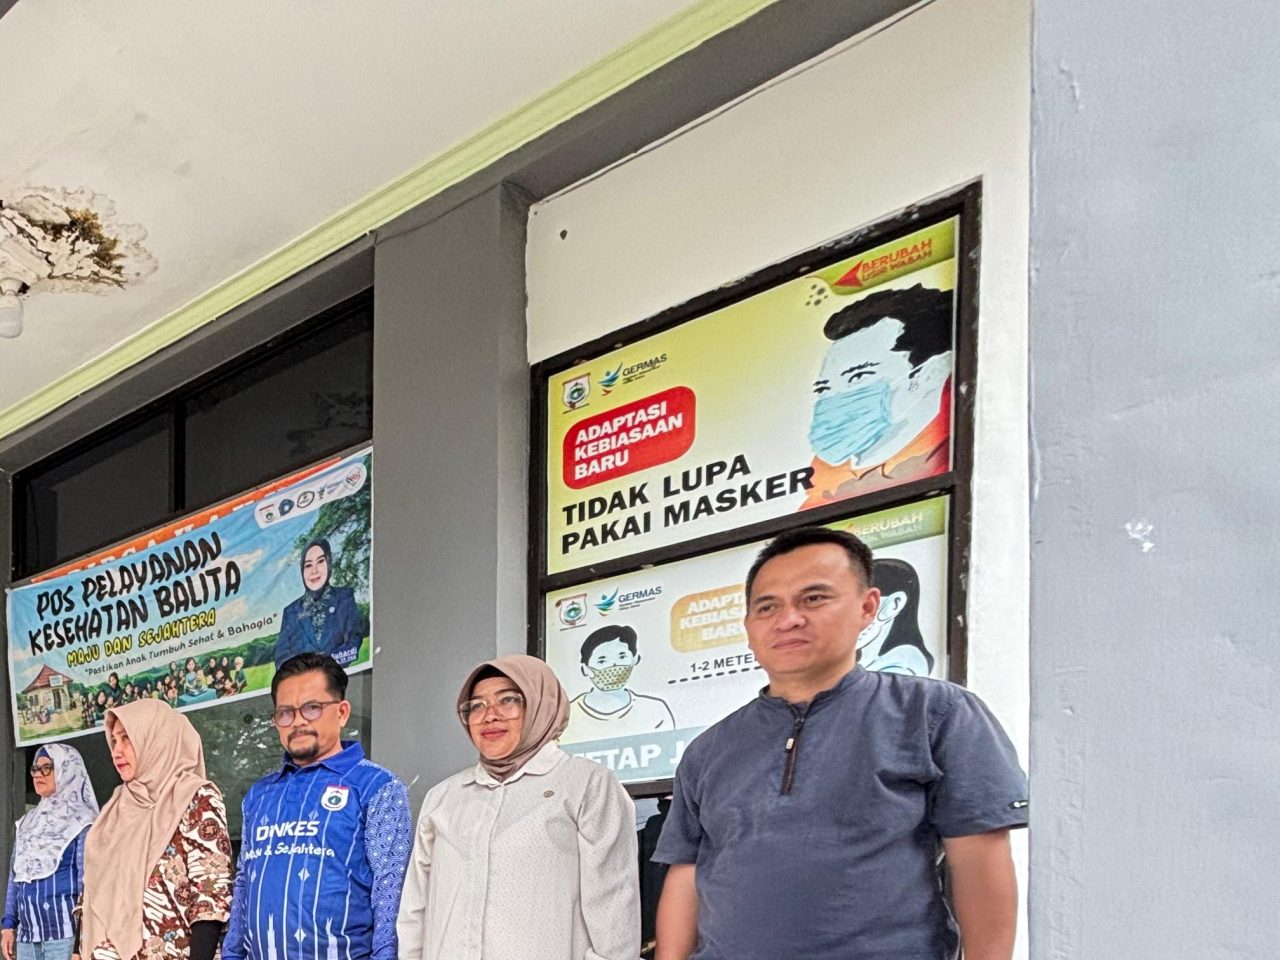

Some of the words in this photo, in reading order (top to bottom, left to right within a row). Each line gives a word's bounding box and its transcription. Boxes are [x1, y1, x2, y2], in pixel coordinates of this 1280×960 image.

[862, 238, 932, 272] BERUBAH
[623, 353, 668, 376] GERMAS
[574, 412, 683, 462] KEBIASAAN
[575, 401, 667, 445] ADAPTASI
[574, 449, 629, 480] BARU
[562, 482, 650, 526] TIDAK
[663, 454, 751, 499] LUPA
[562, 511, 651, 555] PAKAI
[663, 466, 815, 528] MASKER
[36, 585, 75, 621] POS
[81, 531, 222, 608] PELAYANAN
[618, 586, 663, 603] GERMAS
[28, 594, 149, 656] KESEHATAN
[153, 560, 242, 618] BALITA
[66, 644, 100, 668] MAJU
[104, 634, 133, 657] DAN
[138, 607, 217, 648] SEJAHTERA
[126, 655, 147, 667] Anak
[149, 642, 186, 659] Tumbuh
[188, 633, 214, 648] Sehat
[217, 630, 225, 639] &
[690, 661, 710, 673] 1-2
[714, 653, 757, 669] METE
[256, 821, 321, 841] DINKES
[274, 842, 335, 857] Sejahtera
